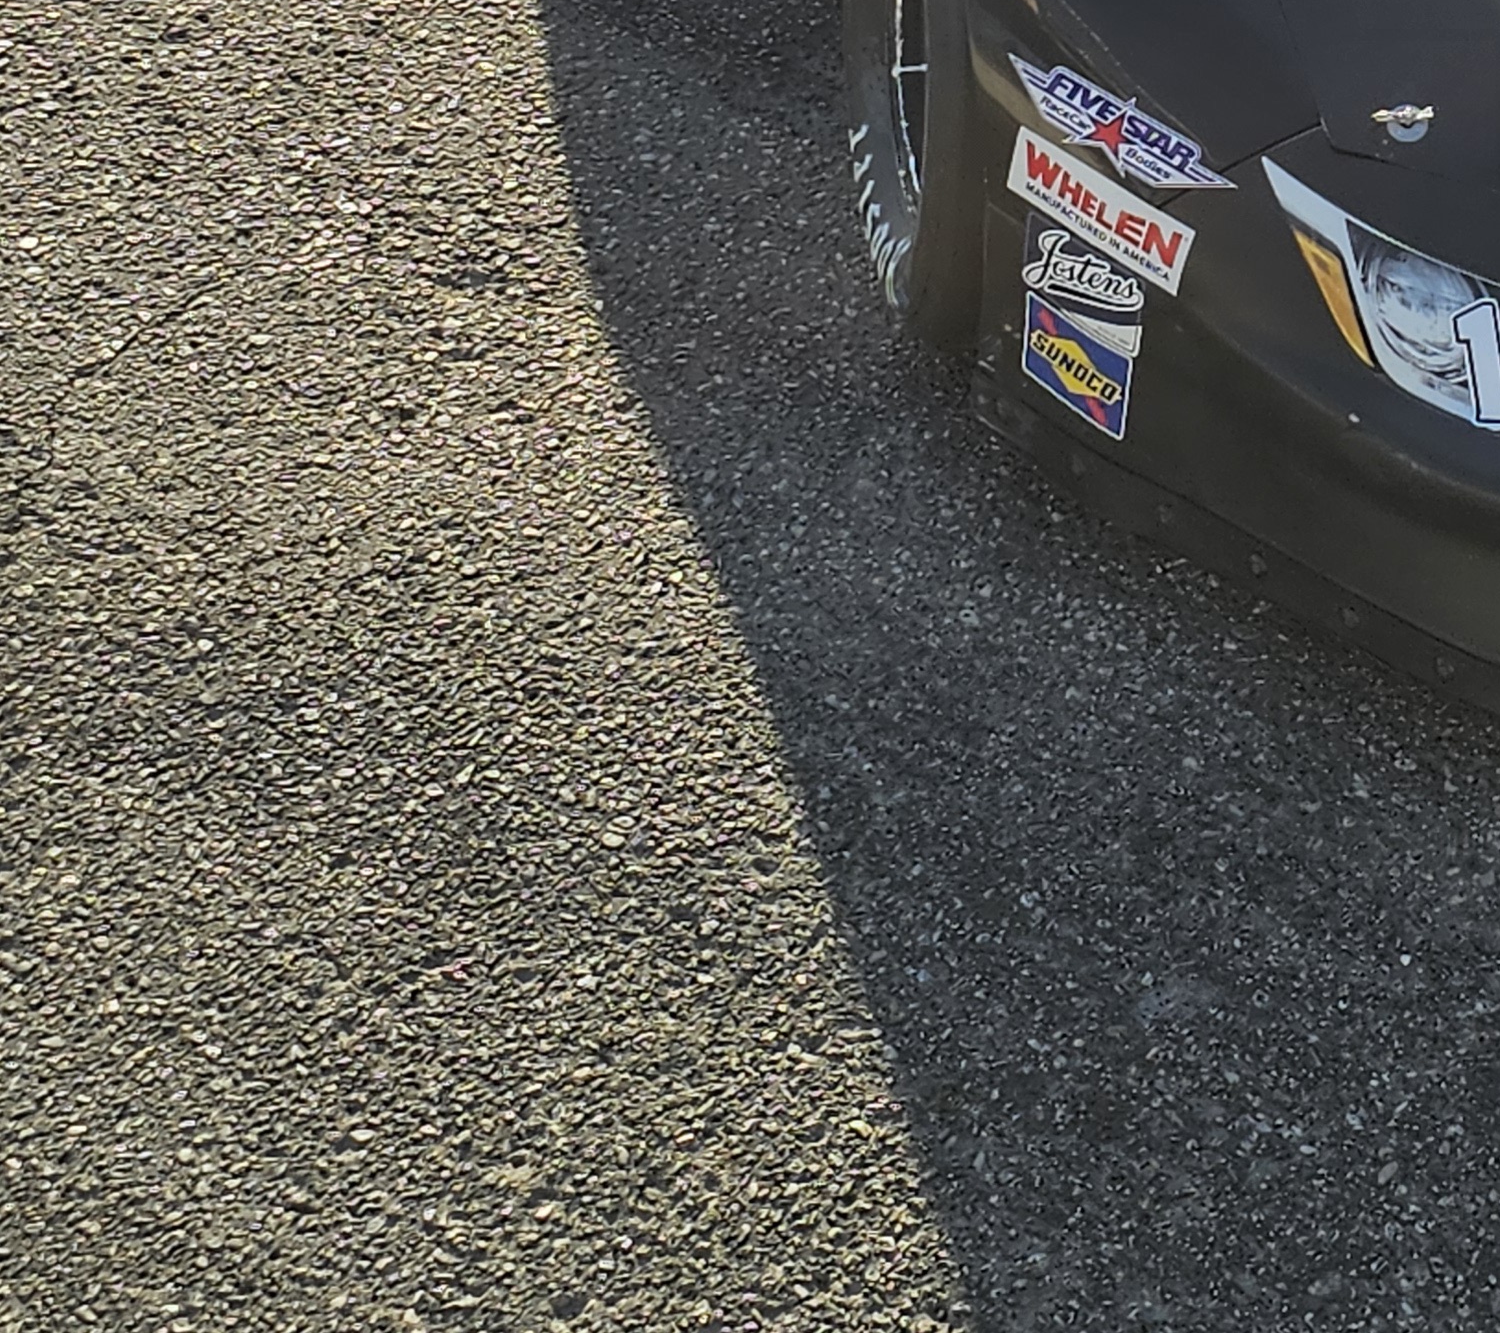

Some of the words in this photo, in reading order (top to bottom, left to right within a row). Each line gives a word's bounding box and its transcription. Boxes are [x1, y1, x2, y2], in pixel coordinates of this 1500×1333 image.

[1046, 71, 1122, 122] FIVE
[1123, 112, 1197, 173] STAR
[1125, 146, 1173, 180] Bodies
[1026, 139, 1184, 269] WHELEN
[1026, 181, 1108, 242] MANUFACTURED
[1109, 236, 1121, 252] IN
[1122, 247, 1171, 282] AMERICA
[1022, 230, 1140, 300] Jostens
[1031, 332, 1122, 403] SUNOCO
